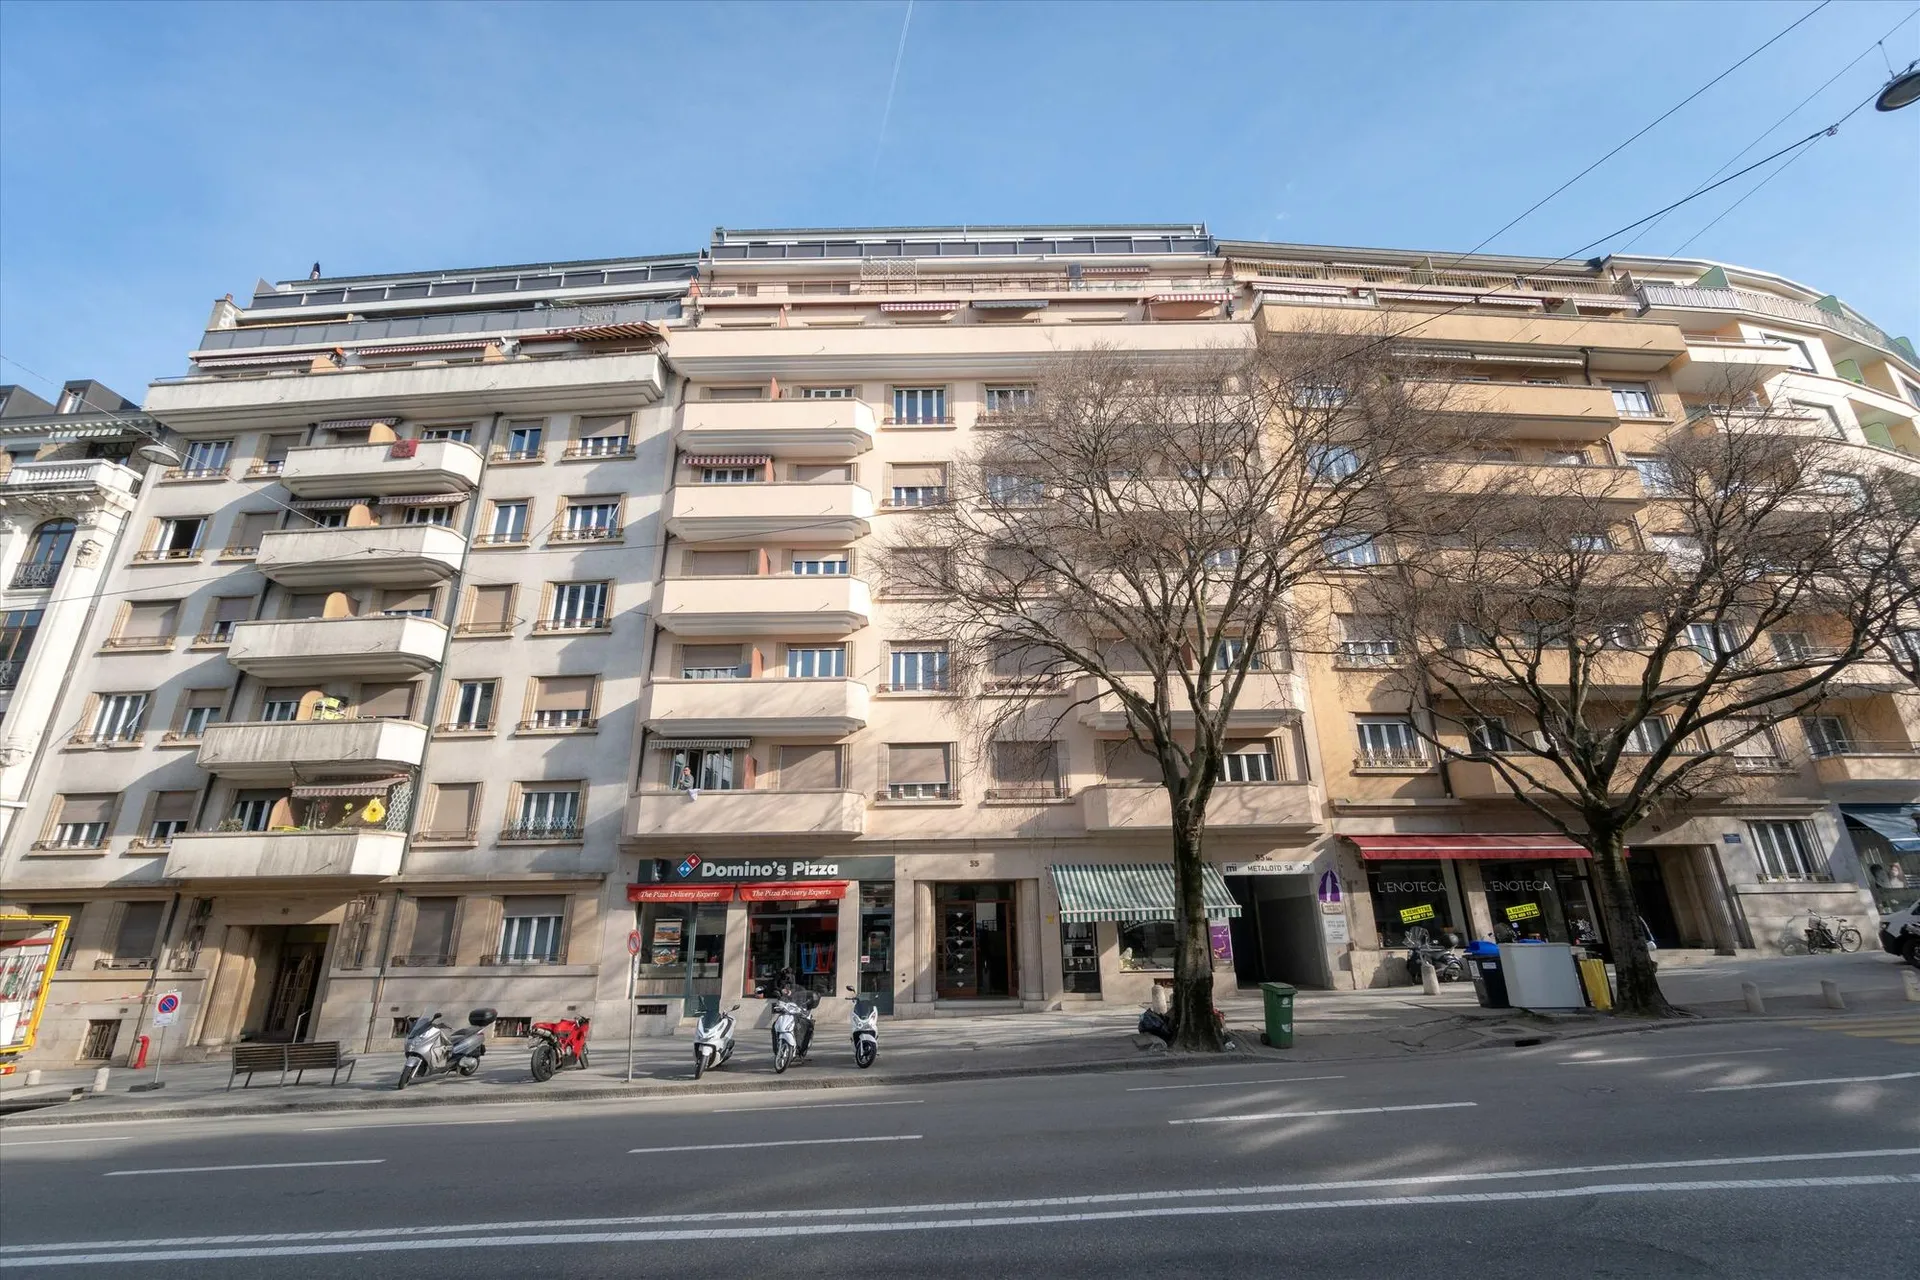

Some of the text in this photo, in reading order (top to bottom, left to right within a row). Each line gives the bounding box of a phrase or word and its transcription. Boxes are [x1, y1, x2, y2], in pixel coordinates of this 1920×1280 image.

[701, 860, 838, 877] Domino's Pizza
[1376, 881, 1447, 893] L'ENOTECA
[669, 891, 697, 899] Delivery
[697, 891, 719, 899] Experts
[764, 889, 780, 897] Pizza
[781, 889, 807, 897] Delivery
[808, 889, 831, 897] Experts
